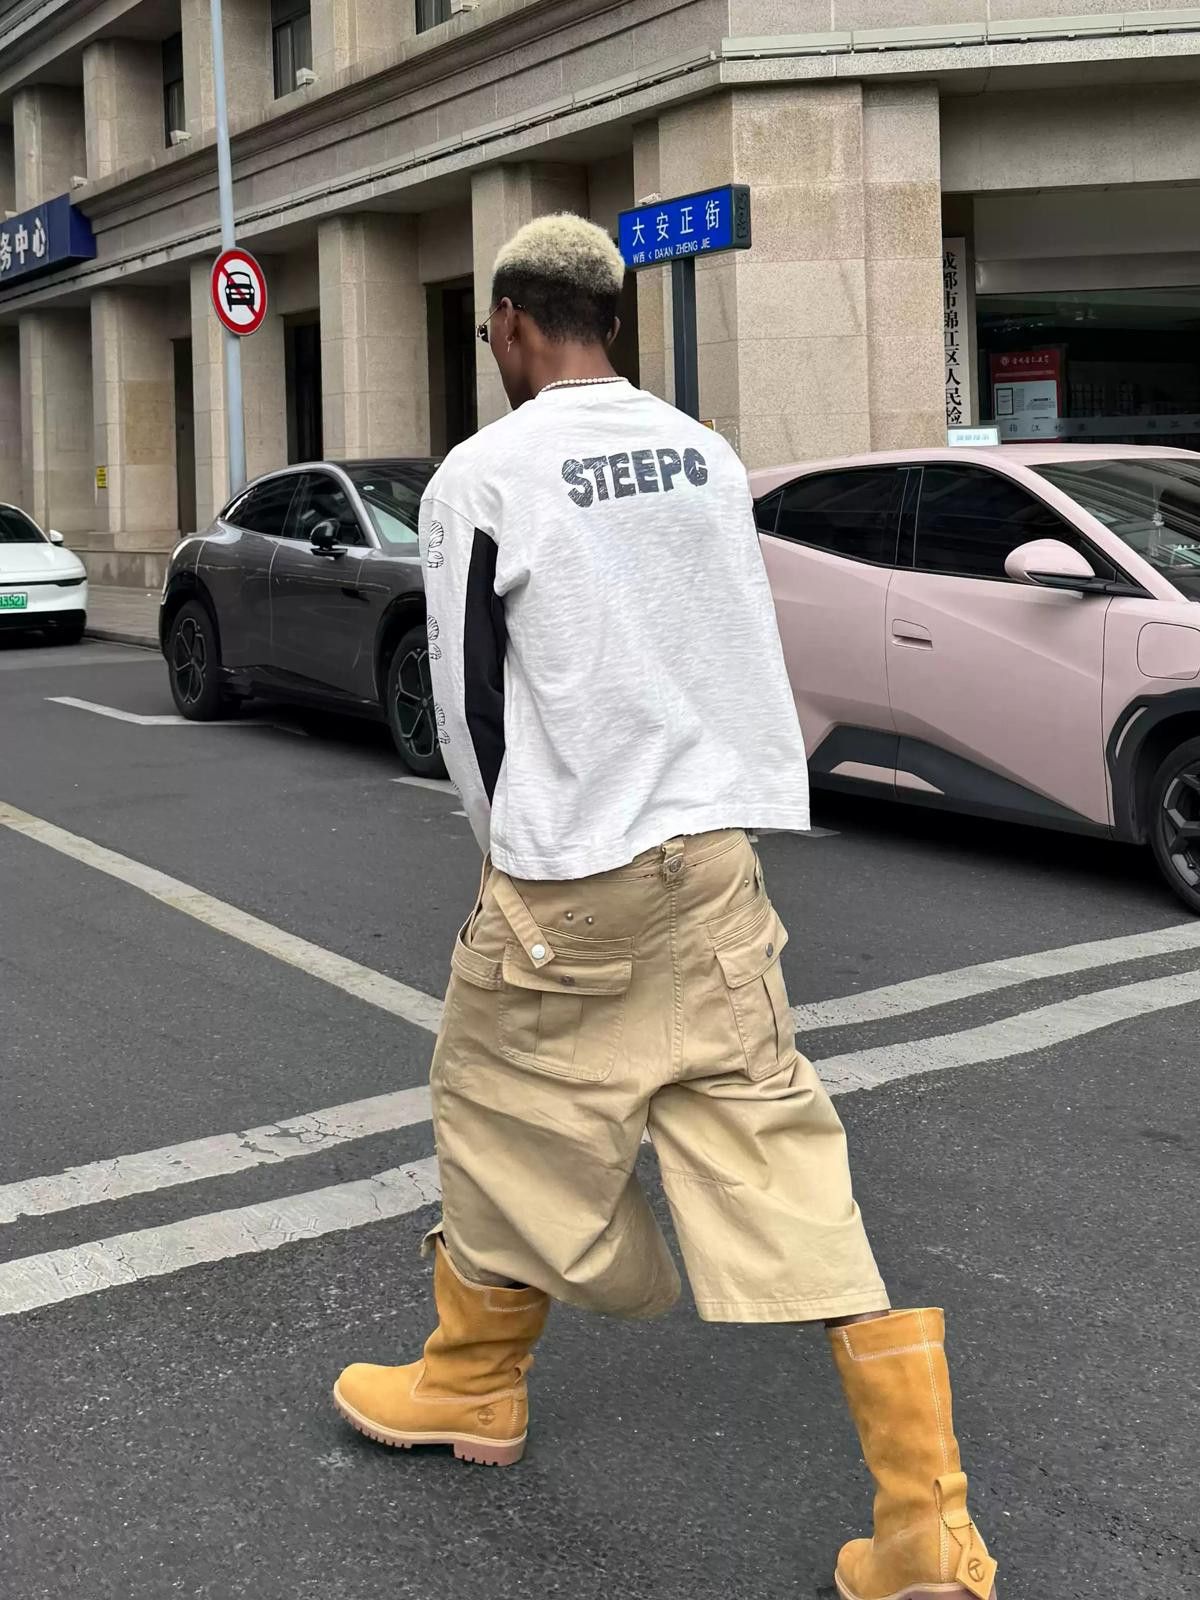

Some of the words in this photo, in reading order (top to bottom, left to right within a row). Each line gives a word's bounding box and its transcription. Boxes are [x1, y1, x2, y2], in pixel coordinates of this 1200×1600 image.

[0, 217, 46, 271] 务中心
[632, 199, 720, 247] 大安正街
[676, 240, 698, 255] ZHENG
[701, 237, 711, 249] JIE
